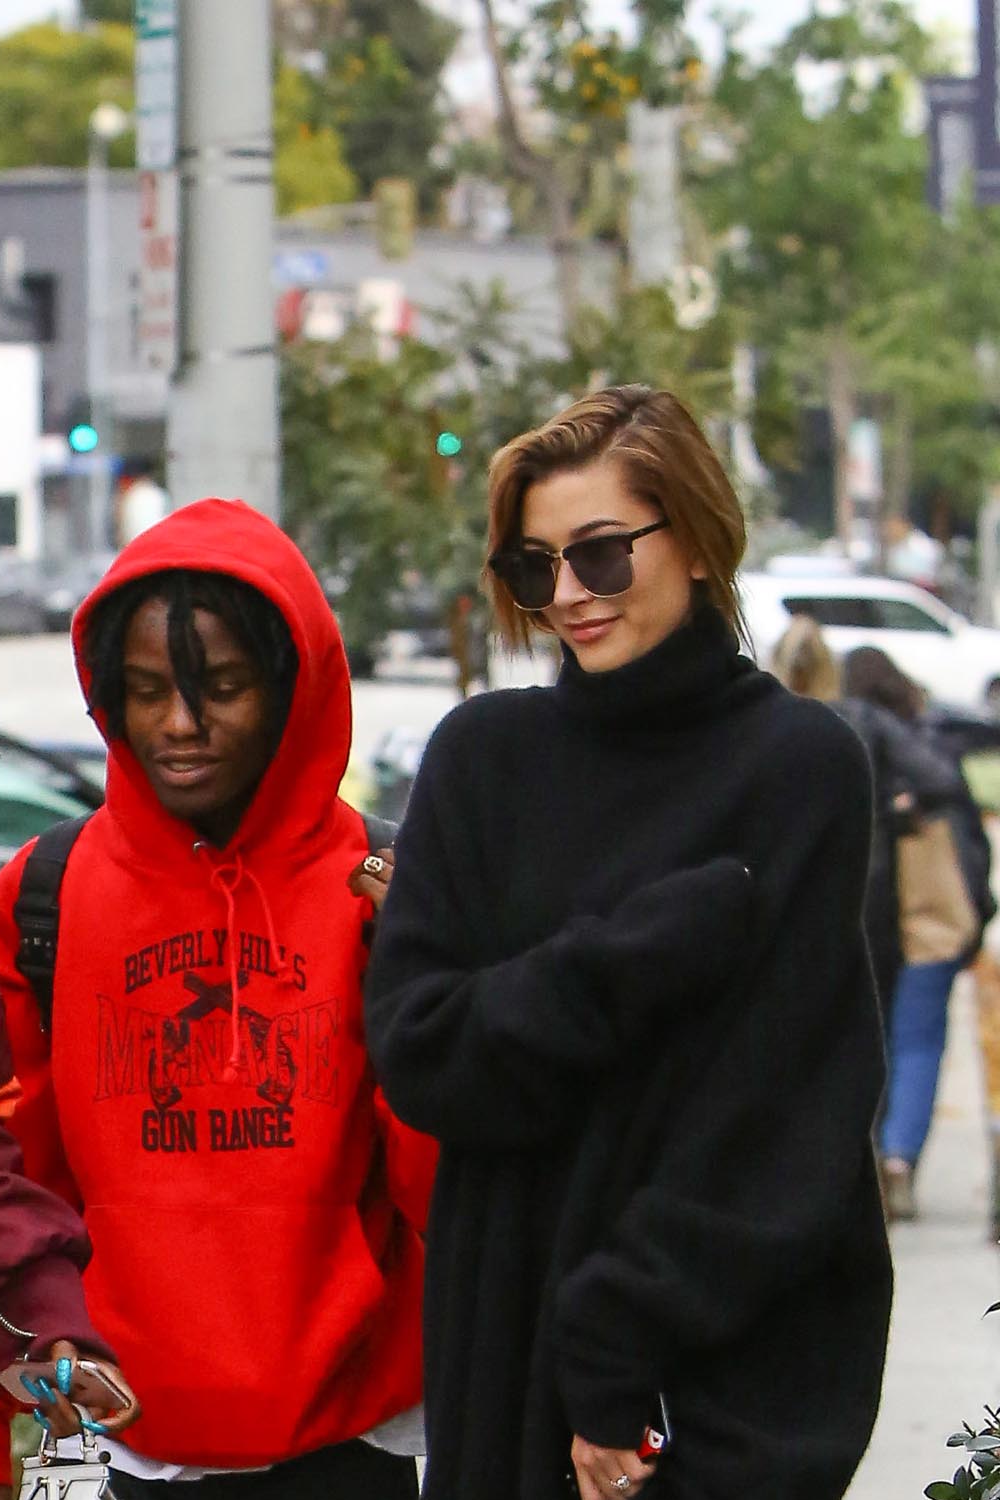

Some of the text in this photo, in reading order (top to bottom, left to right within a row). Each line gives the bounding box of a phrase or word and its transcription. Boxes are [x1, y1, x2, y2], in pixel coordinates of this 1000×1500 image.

[124, 928, 228, 994] BEVERLY
[141, 1107, 295, 1152] GUN RANGE
